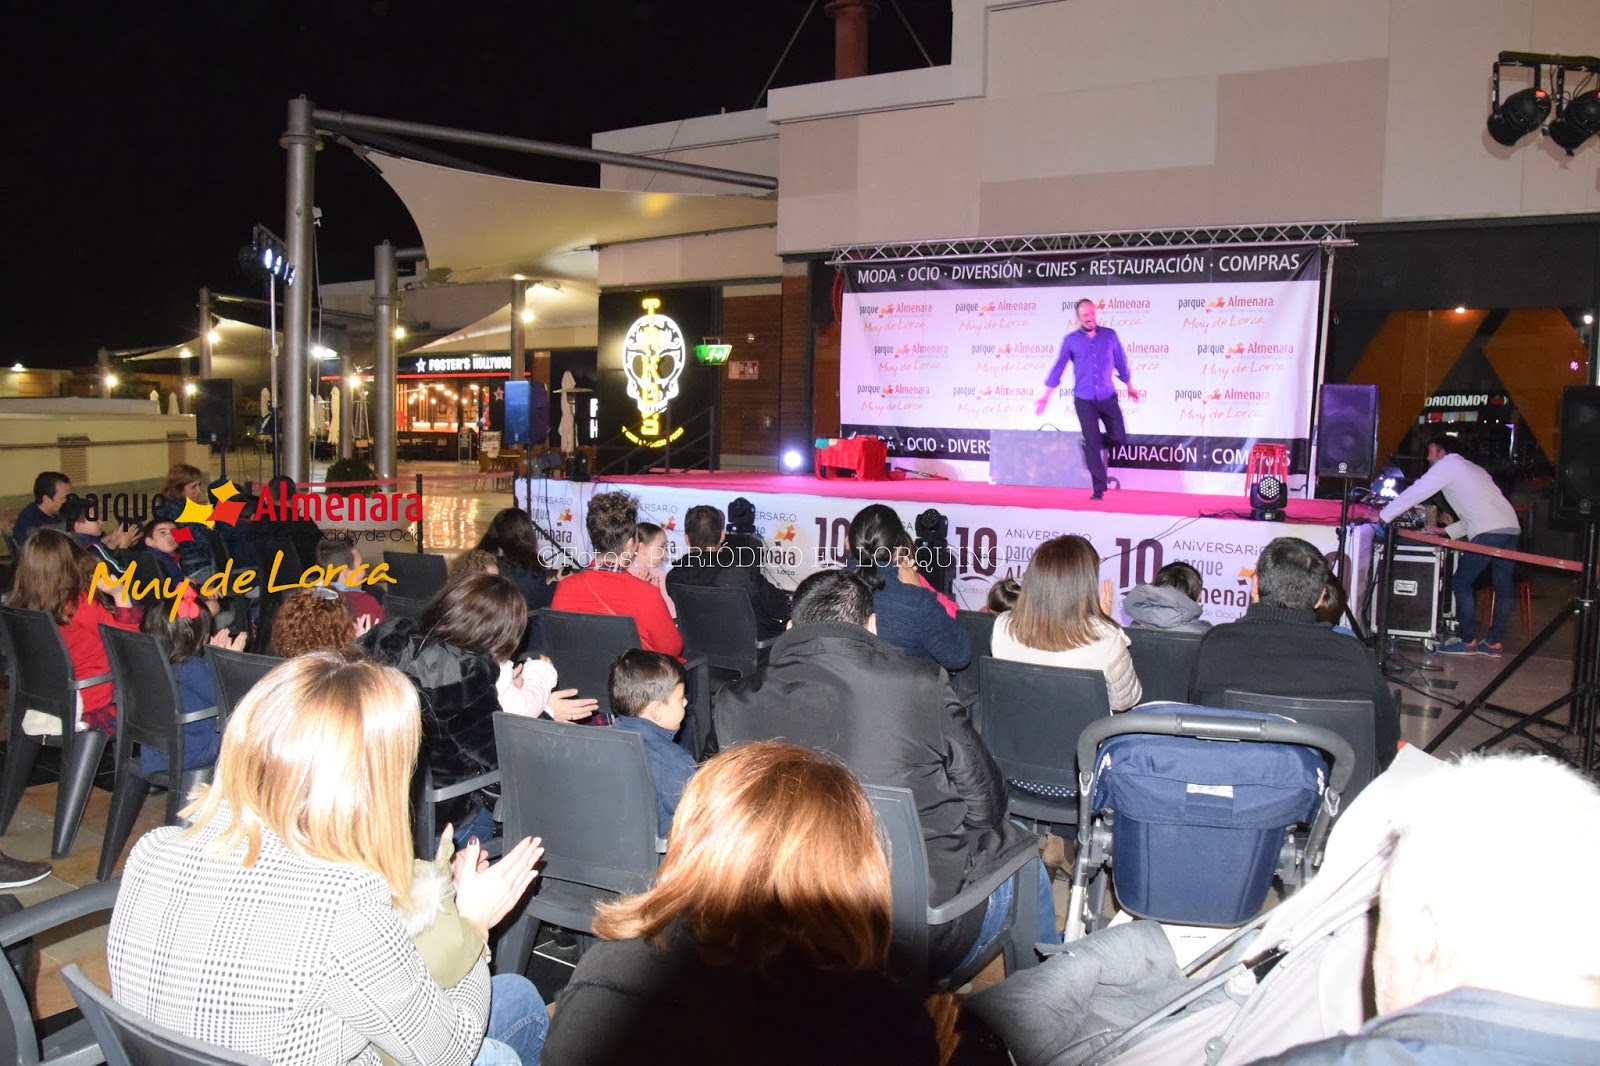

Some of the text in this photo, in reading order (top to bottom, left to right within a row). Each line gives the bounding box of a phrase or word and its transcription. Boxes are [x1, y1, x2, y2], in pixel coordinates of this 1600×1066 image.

[858, 253, 1300, 284] MODA OCIO DIVERSIÓN CINES RESTAURACIÓN COMPRAS
[859, 305, 879, 316] parque
[896, 302, 932, 313] Almenara
[955, 300, 1037, 314] parque Almenara
[1107, 297, 1151, 309] Almenara
[1178, 295, 1274, 310] parque Almenara
[911, 343, 948, 354] Almenara
[971, 342, 1054, 356] parque Almenara
[1126, 342, 1169, 354] Almenara
[1197, 342, 1294, 356] parque Almenara
[429, 356, 511, 371] FOSTER'S HOLLYWOO
[857, 384, 930, 395] parque Almenara
[952, 384, 1034, 397] parque Almenara
[1175, 388, 1270, 401] parque Almenara
[907, 436, 937, 452] OCIO
[948, 438, 990, 454] DIVERS
[815, 517, 851, 564] 10
[955, 527, 998, 577] 10
[1116, 537, 1164, 589] 10
[1215, 609, 1235, 620] Ocio
